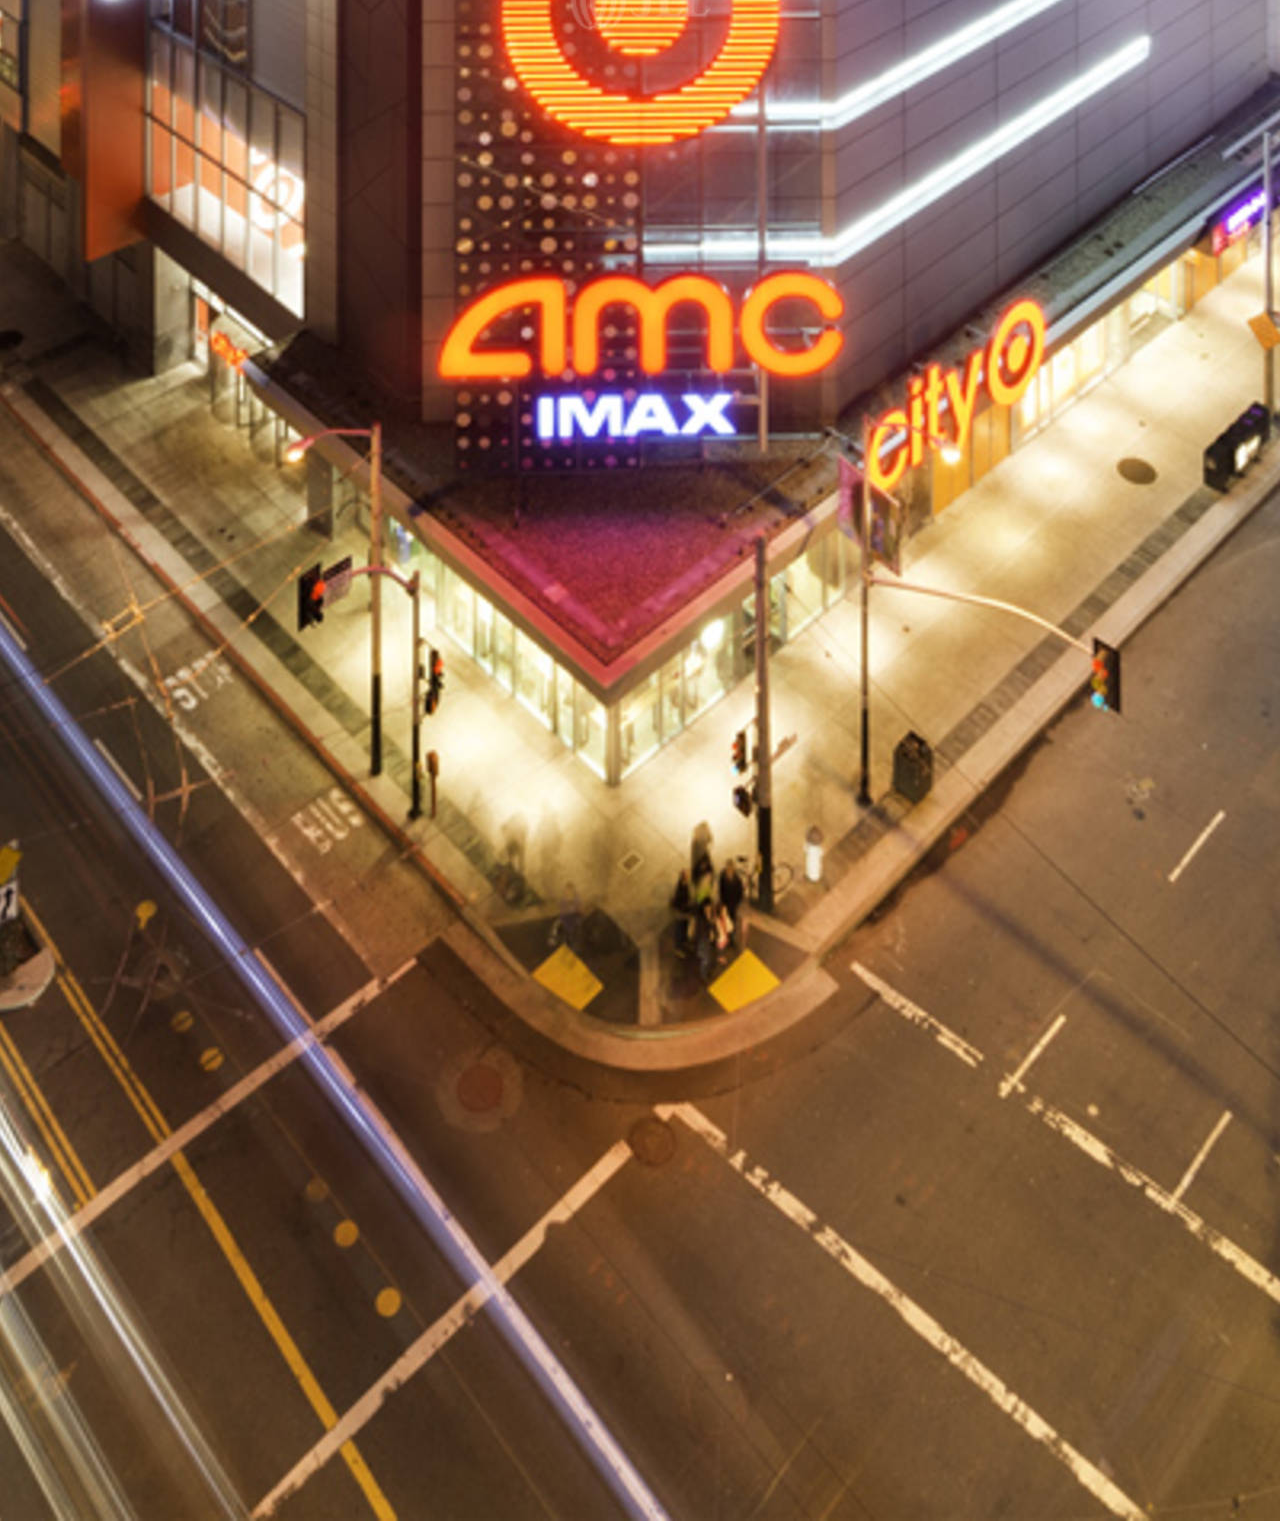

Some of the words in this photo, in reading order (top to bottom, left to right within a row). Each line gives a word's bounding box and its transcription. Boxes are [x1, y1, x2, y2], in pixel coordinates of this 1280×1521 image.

[535, 390, 738, 438] IMAX
[866, 348, 984, 492] city
[290, 786, 365, 856] BUS
